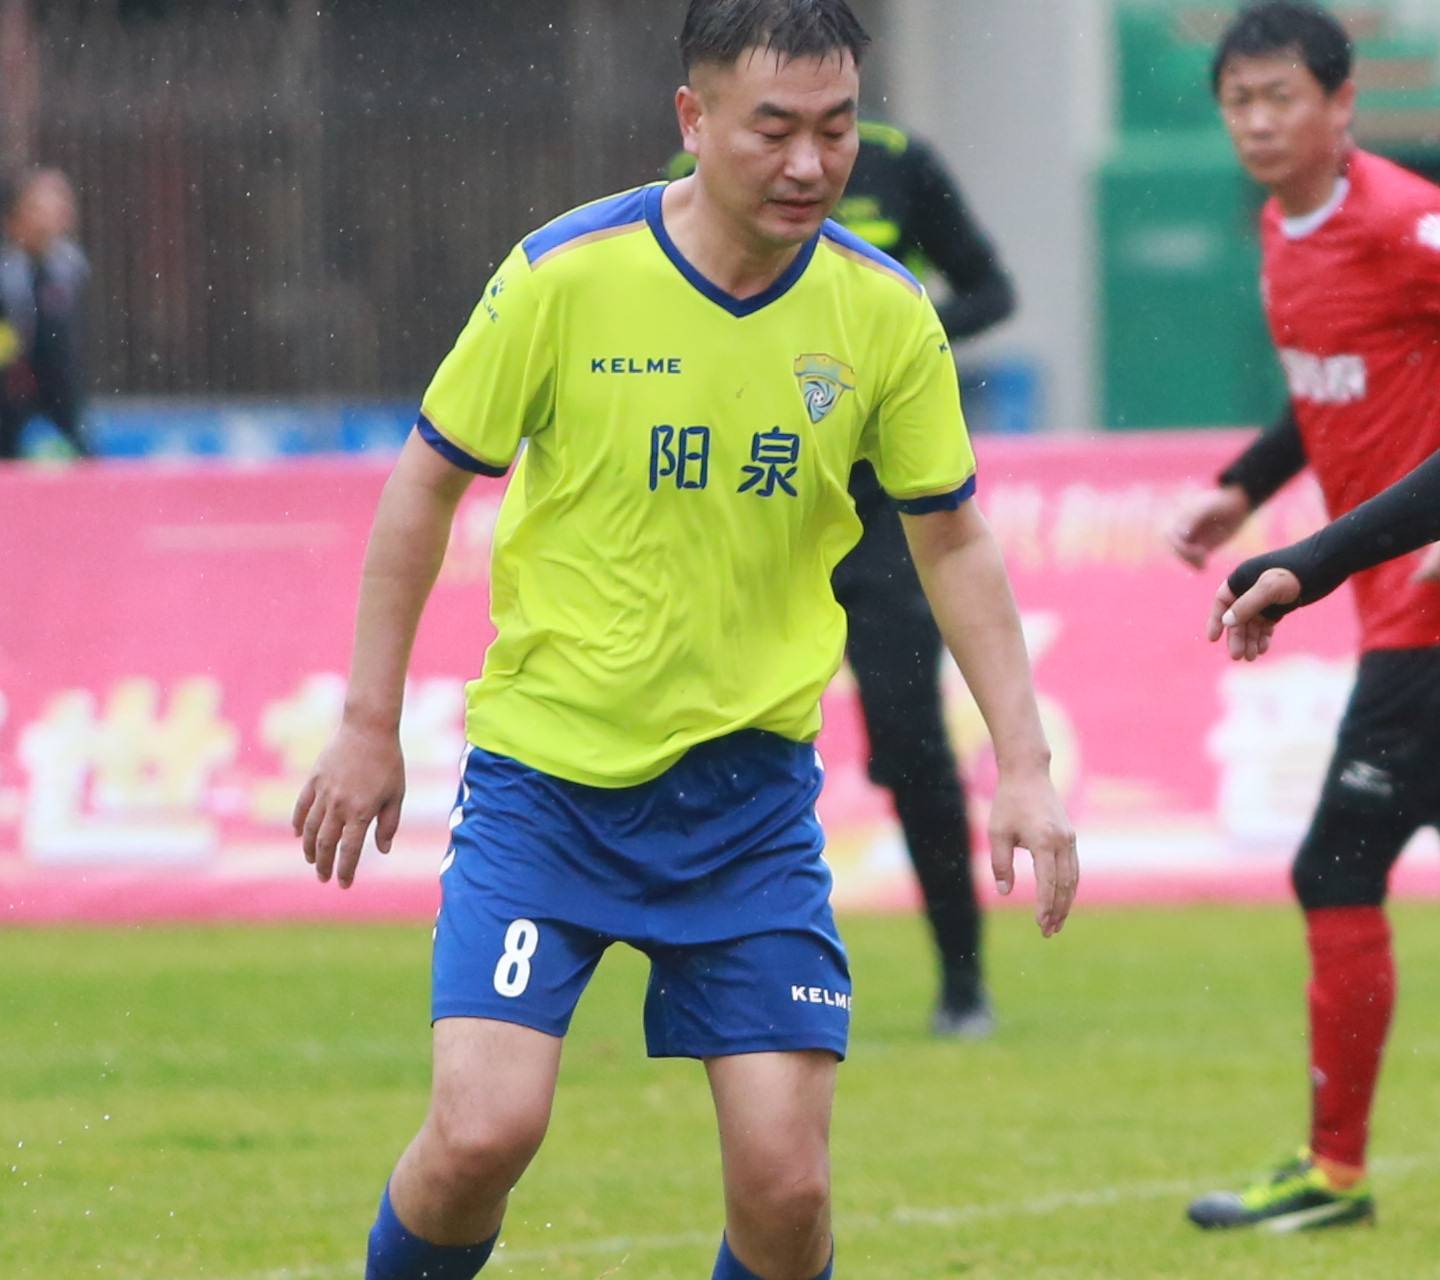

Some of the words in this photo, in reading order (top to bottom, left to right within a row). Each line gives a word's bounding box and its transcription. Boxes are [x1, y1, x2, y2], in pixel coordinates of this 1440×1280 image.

[591, 357, 683, 374] KELME
[649, 424, 801, 498] 阳泉
[493, 919, 539, 998] 8
